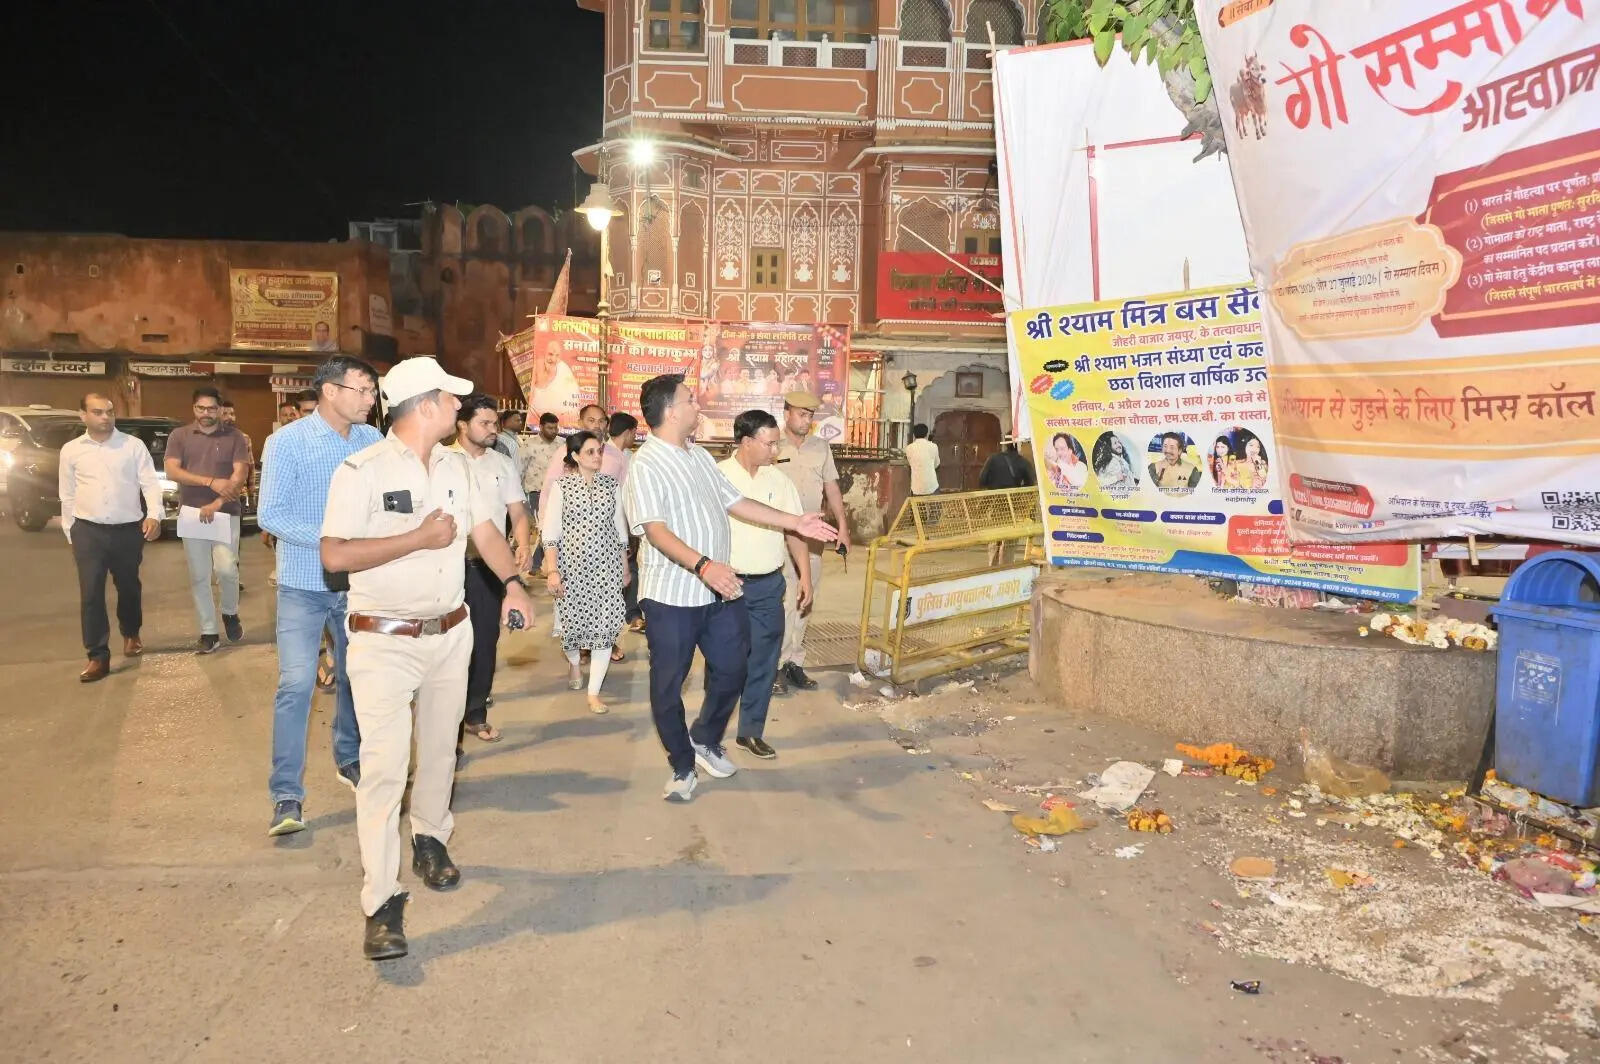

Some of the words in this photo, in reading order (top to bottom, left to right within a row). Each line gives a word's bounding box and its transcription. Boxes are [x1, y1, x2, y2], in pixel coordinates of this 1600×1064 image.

[1482, 195, 1502, 208] भारत
[1504, 188, 1512, 202] में
[1546, 181, 1560, 193] पर
[1527, 204, 1548, 217] माता
[1551, 240, 1576, 253] प्रदान
[1556, 258, 1585, 275] कानून
[1358, 273, 1377, 286] 2026
[1026, 312, 1052, 339] श्री
[1059, 311, 1115, 335] श्याम
[1121, 300, 1168, 329] मित्र
[1174, 296, 1219, 320] बस
[1139, 332, 1164, 344] बाजार
[1167, 330, 1197, 343] जयपुर,
[1200, 325, 1210, 337] के
[1074, 355, 1090, 372] श्री
[1094, 353, 1127, 370] श्याम
[1130, 350, 1162, 368] भजन
[1166, 346, 1204, 364] संध्या
[1208, 340, 1232, 360] एवं
[12, 360, 45, 371] दर्शन
[51, 360, 90, 372] टायर्स
[1107, 377, 1134, 390] छठा
[1137, 372, 1186, 389] विशाल
[1189, 363, 1240, 386] वार्षिक
[1072, 401, 1105, 412] शनिवार,
[1144, 399, 1170, 409] 2026
[1182, 394, 1203, 406] सायं
[1206, 395, 1231, 405] 7:00
[1234, 391, 1254, 404] बजे
[1256, 390, 1267, 402] से
[1329, 388, 1346, 419] से
[1350, 388, 1389, 431] जुड़ने
[1393, 388, 1412, 420] के
[1414, 387, 1456, 429] लिए
[1461, 386, 1521, 421] मिस
[1528, 382, 1596, 420] कॉल
[1046, 417, 1069, 427] सत्संग
[1070, 418, 1092, 426] स्थल
[1100, 416, 1126, 426] पहला
[1128, 413, 1161, 425] चौराहा,
[1219, 411, 1235, 421] का
[1238, 410, 1271, 421] रास्ता,
